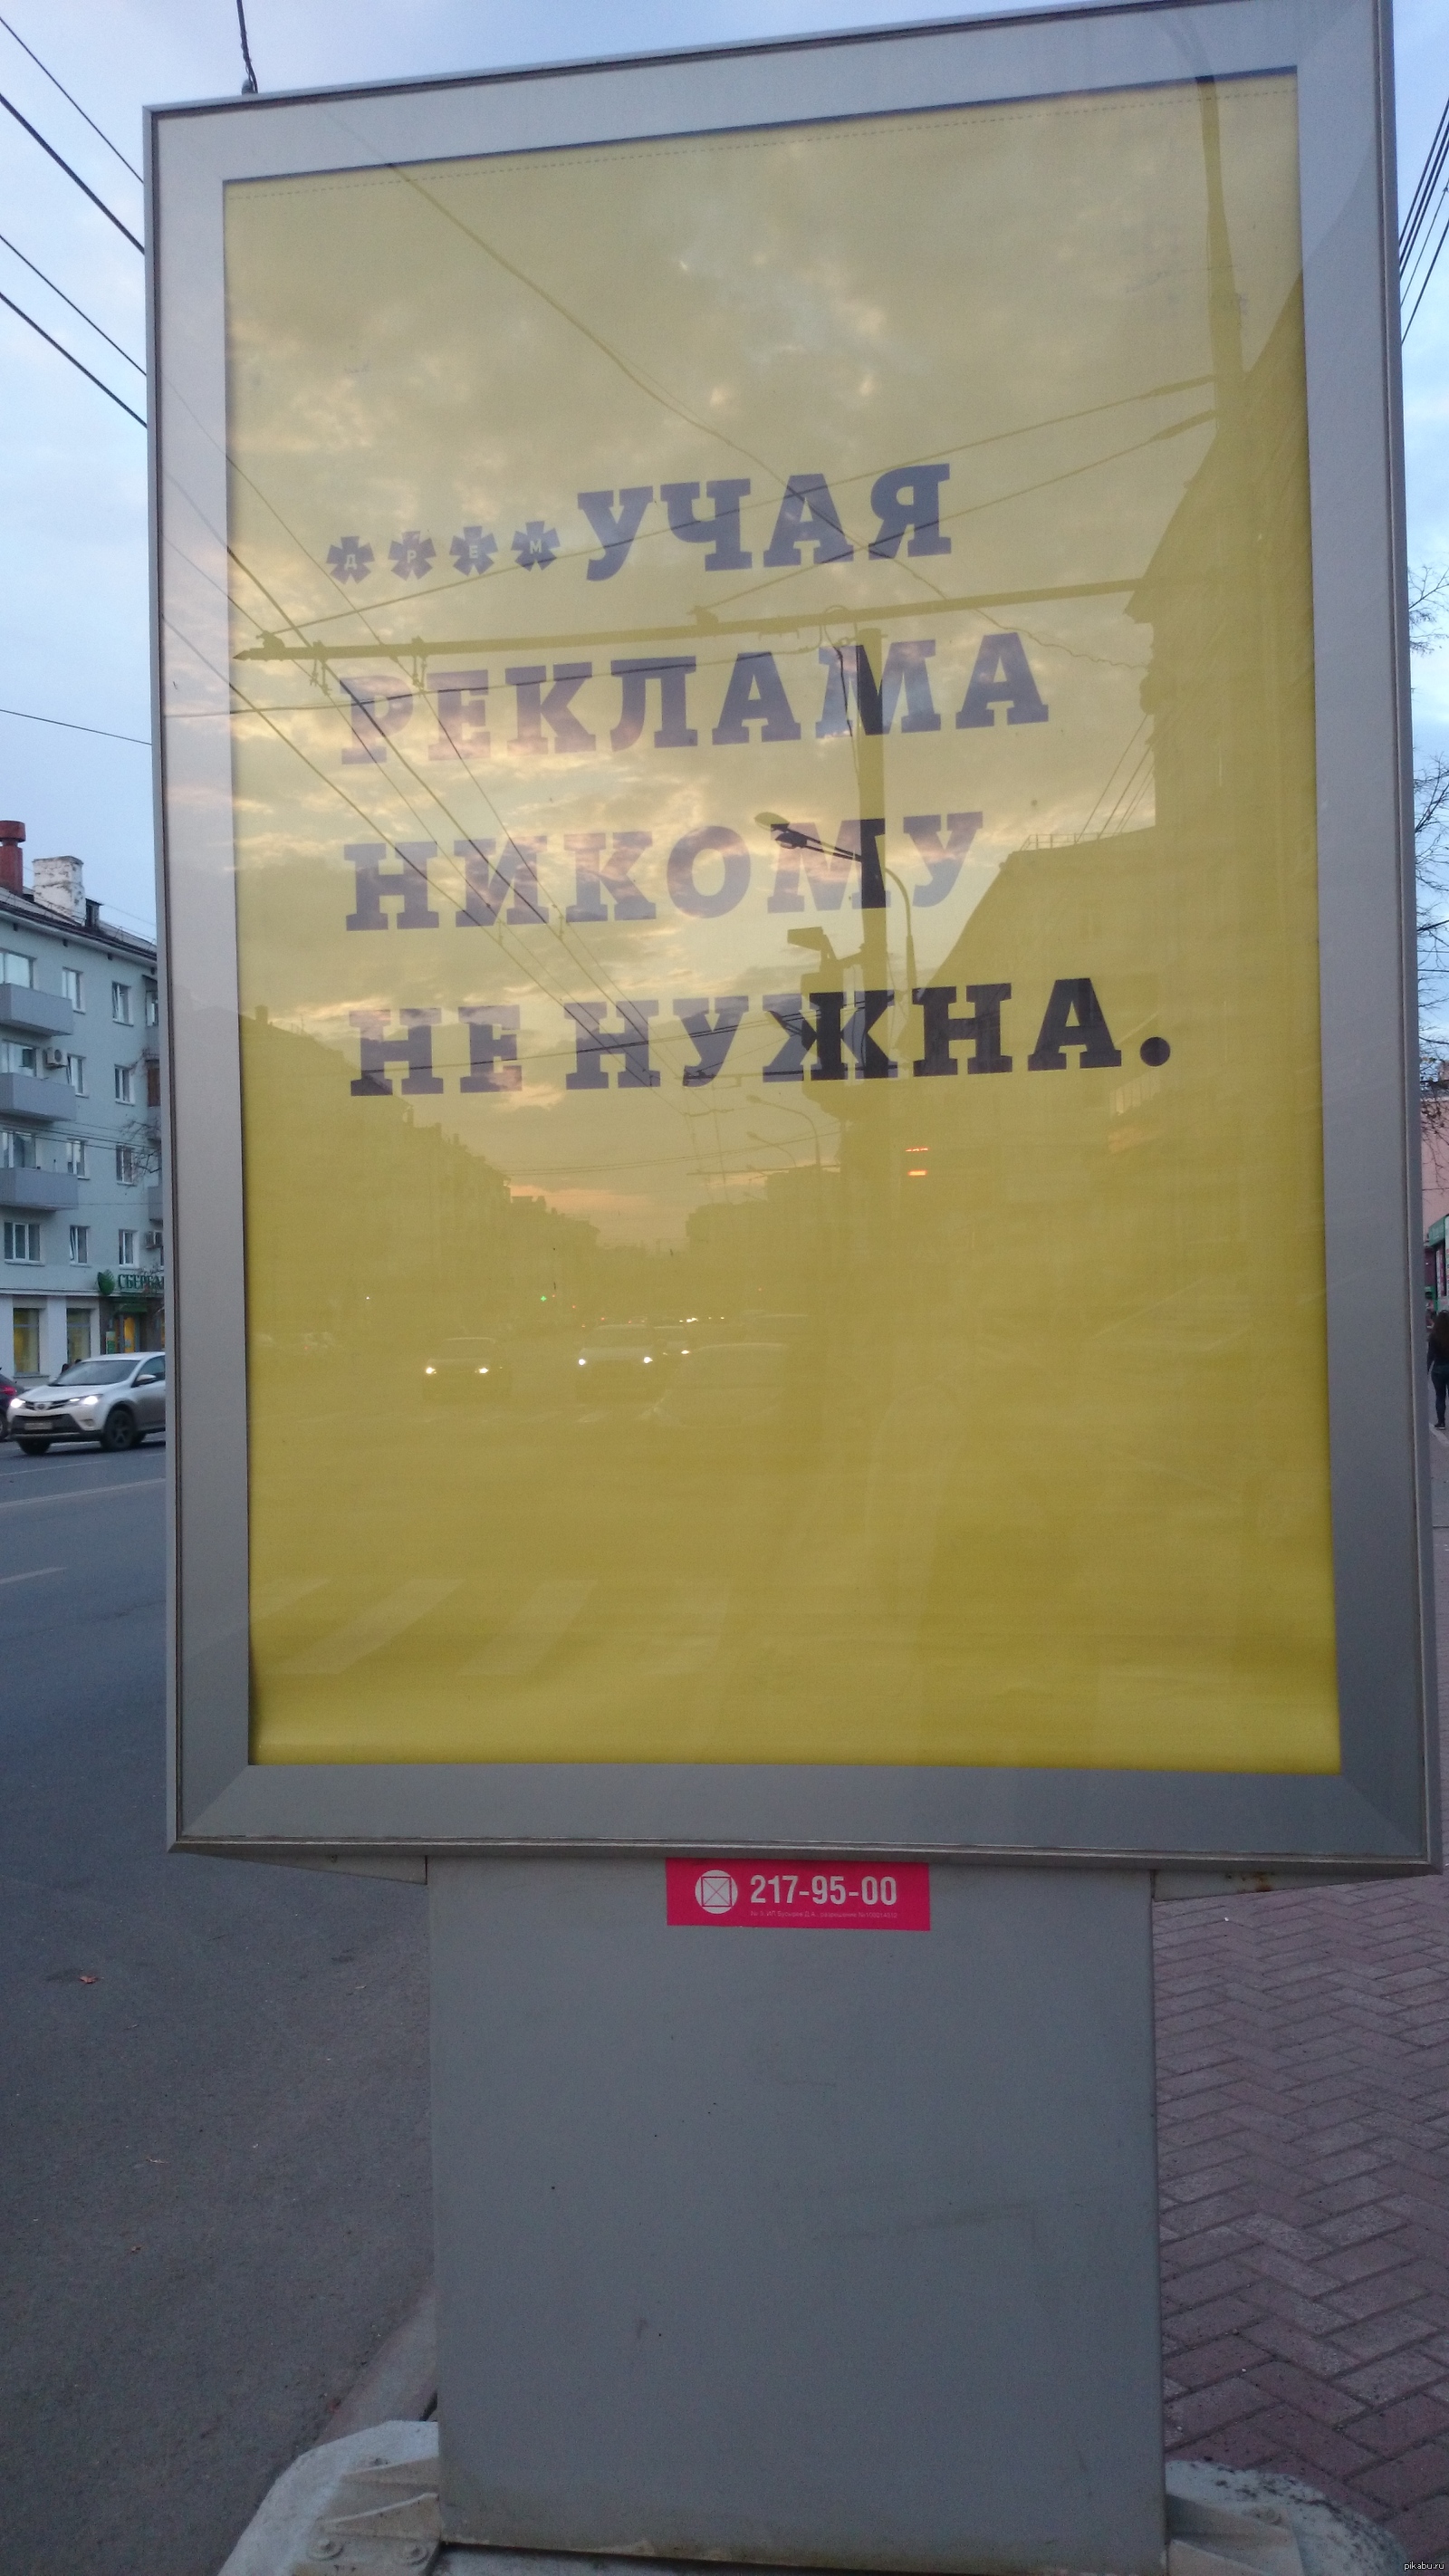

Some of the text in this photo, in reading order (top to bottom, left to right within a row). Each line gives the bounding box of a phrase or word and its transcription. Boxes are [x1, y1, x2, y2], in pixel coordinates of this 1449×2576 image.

[341, 632, 1049, 764] РЕКЛАМА
[344, 812, 984, 931] НИКОМУ
[350, 977, 1171, 1097] НЕ НУЖНА.
[118, 1274, 164, 1289] СБЕРБА
[750, 1875, 897, 1905] 217-95-00
